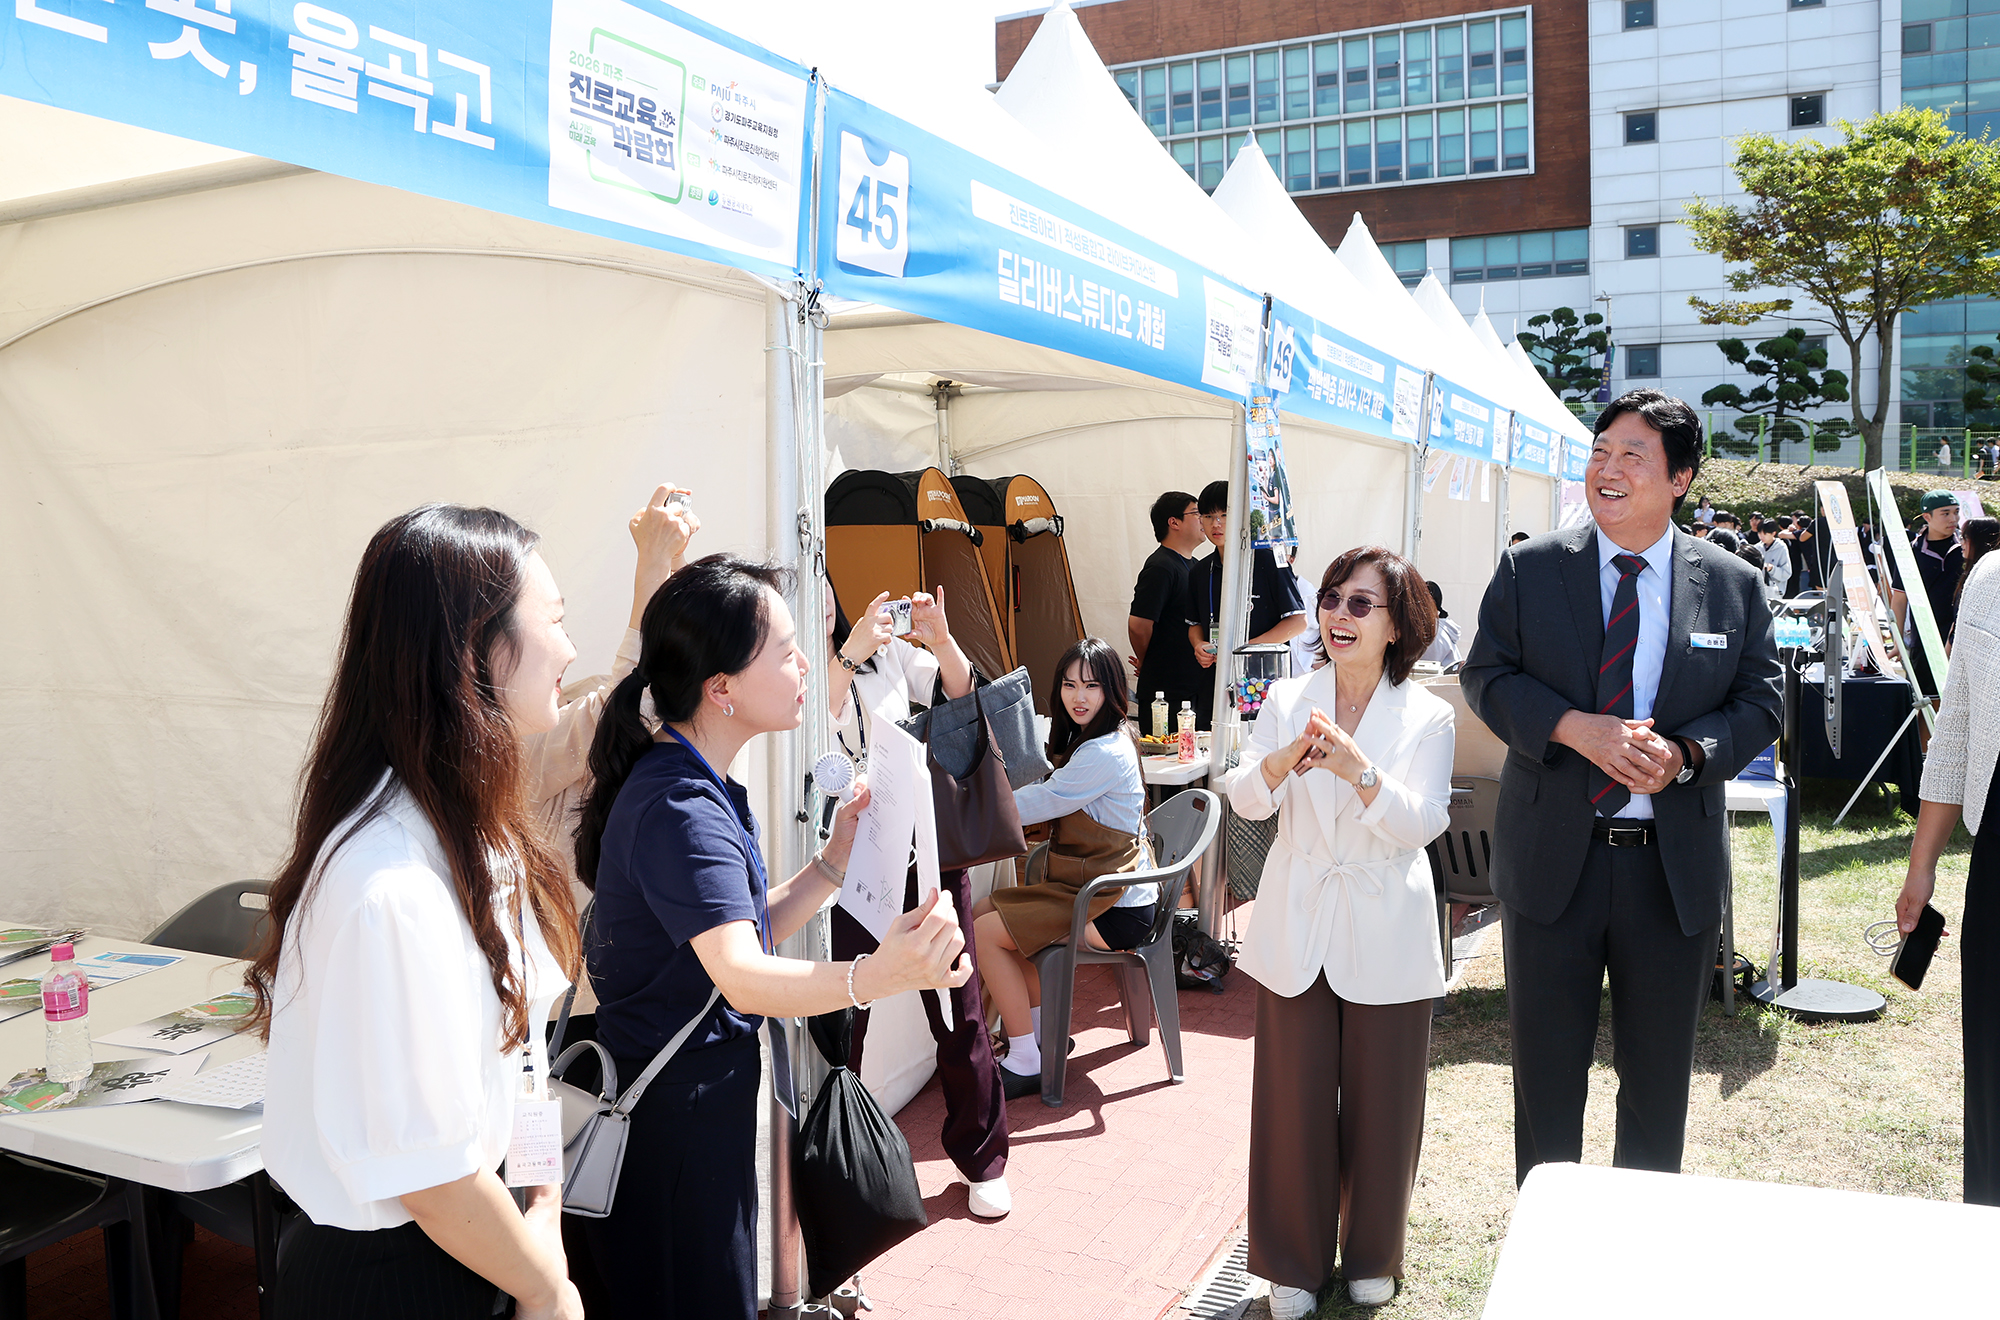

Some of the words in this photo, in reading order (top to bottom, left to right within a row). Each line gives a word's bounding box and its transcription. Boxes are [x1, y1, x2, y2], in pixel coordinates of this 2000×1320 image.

[288, 2, 495, 150] 율곡고
[569, 50, 600, 74] 2026
[603, 62, 623, 82] 파주
[569, 71, 659, 131] 진로교육
[711, 83, 731, 102] PAJU
[735, 92, 756, 111] 파주시
[569, 120, 578, 130] AI
[569, 131, 582, 144] 미래
[583, 134, 597, 147] 교육
[725, 110, 779, 139] 경기도파주교육지원청
[613, 124, 675, 171] 박람회
[723, 135, 780, 163] 파주시진로진학지원센터
[846, 174, 899, 251] 45
[1009, 203, 1057, 242] 진로동아리
[1064, 227, 1105, 261] 적성융합고
[1106, 247, 1157, 284] 라이브커머스반
[998, 248, 1133, 339] 딜리버스튜디오
[1136, 299, 1166, 351] 체험
[1273, 340, 1292, 380] 46
